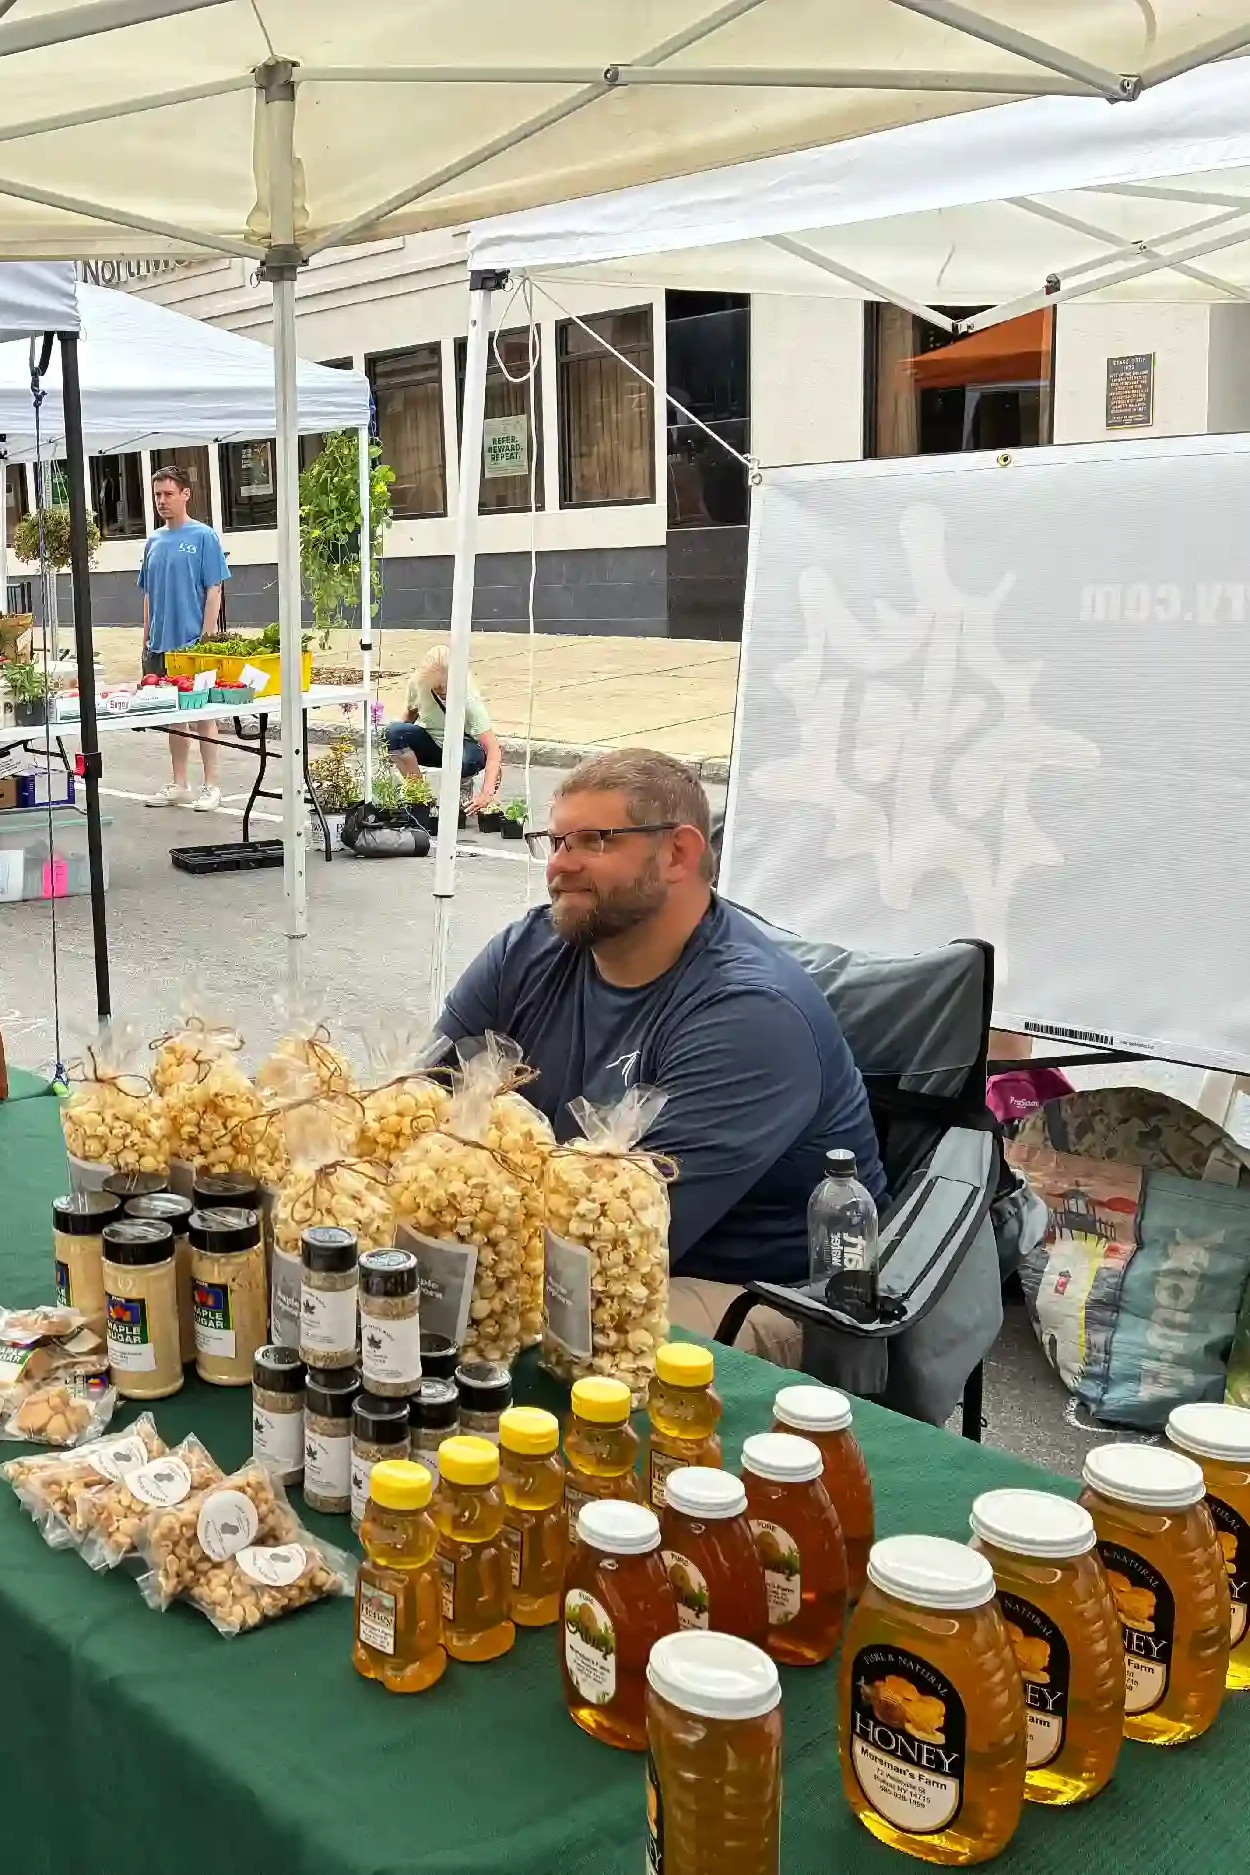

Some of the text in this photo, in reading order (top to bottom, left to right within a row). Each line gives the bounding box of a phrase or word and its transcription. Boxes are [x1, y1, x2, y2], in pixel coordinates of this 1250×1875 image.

[492, 435, 518, 445] REFER.
[488, 444, 524, 454] REWARD.
[490, 452, 521, 462] REPEAT.
[107, 1320, 141, 1335] MAPLE
[1127, 1657, 1155, 1675] Farm
[898, 1655, 949, 1697] NATURAL
[855, 1711, 960, 1774] HONEY
[918, 1771, 948, 1791] Farm
